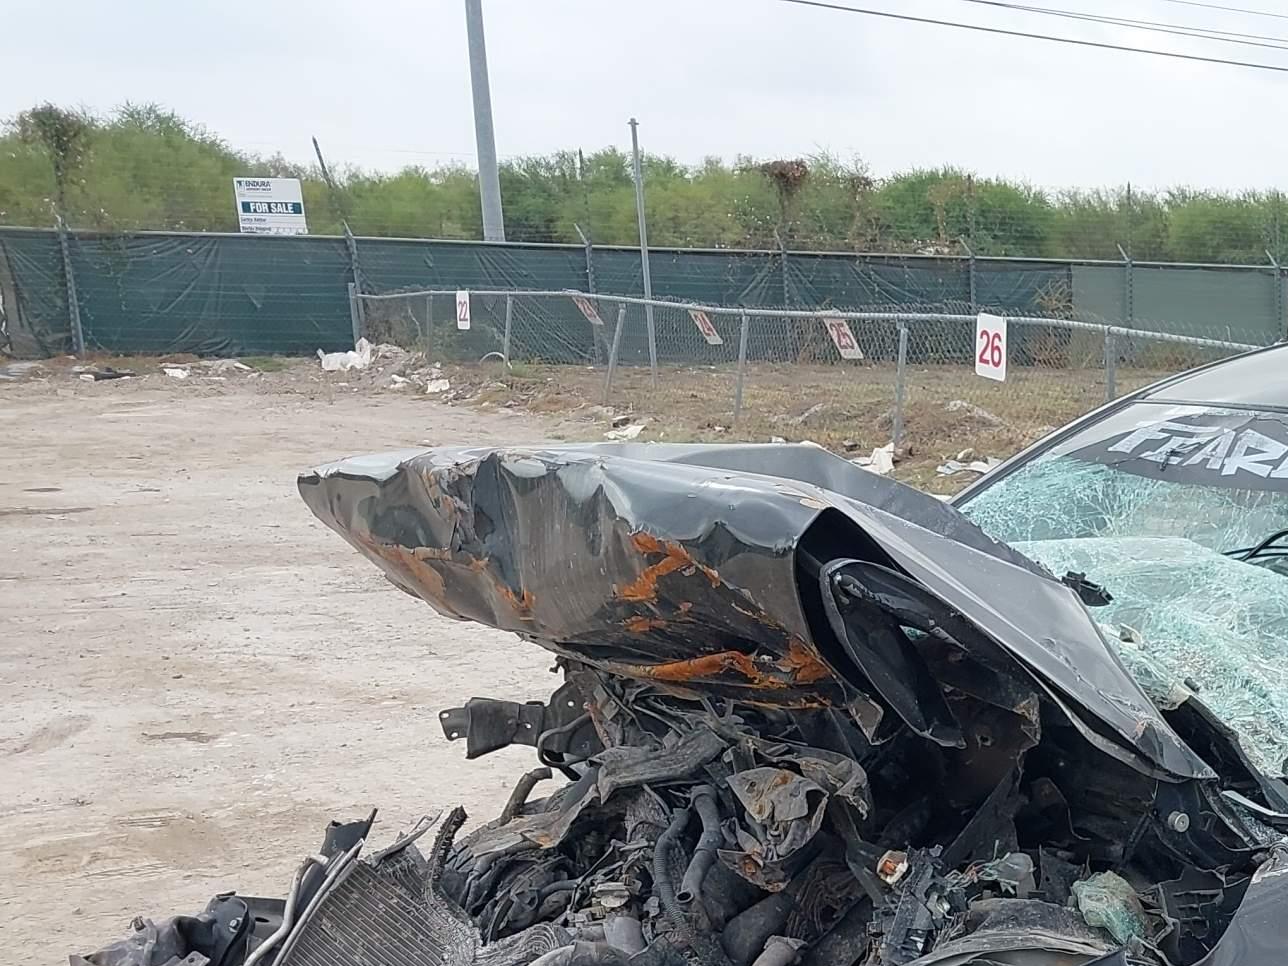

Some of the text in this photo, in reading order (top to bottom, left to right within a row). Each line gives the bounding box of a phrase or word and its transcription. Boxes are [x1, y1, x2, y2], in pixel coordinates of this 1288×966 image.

[249, 203, 294, 213] FOR SALE
[457, 300, 469, 321] 22
[829, 322, 855, 349] 25
[979, 330, 1002, 368] 26
